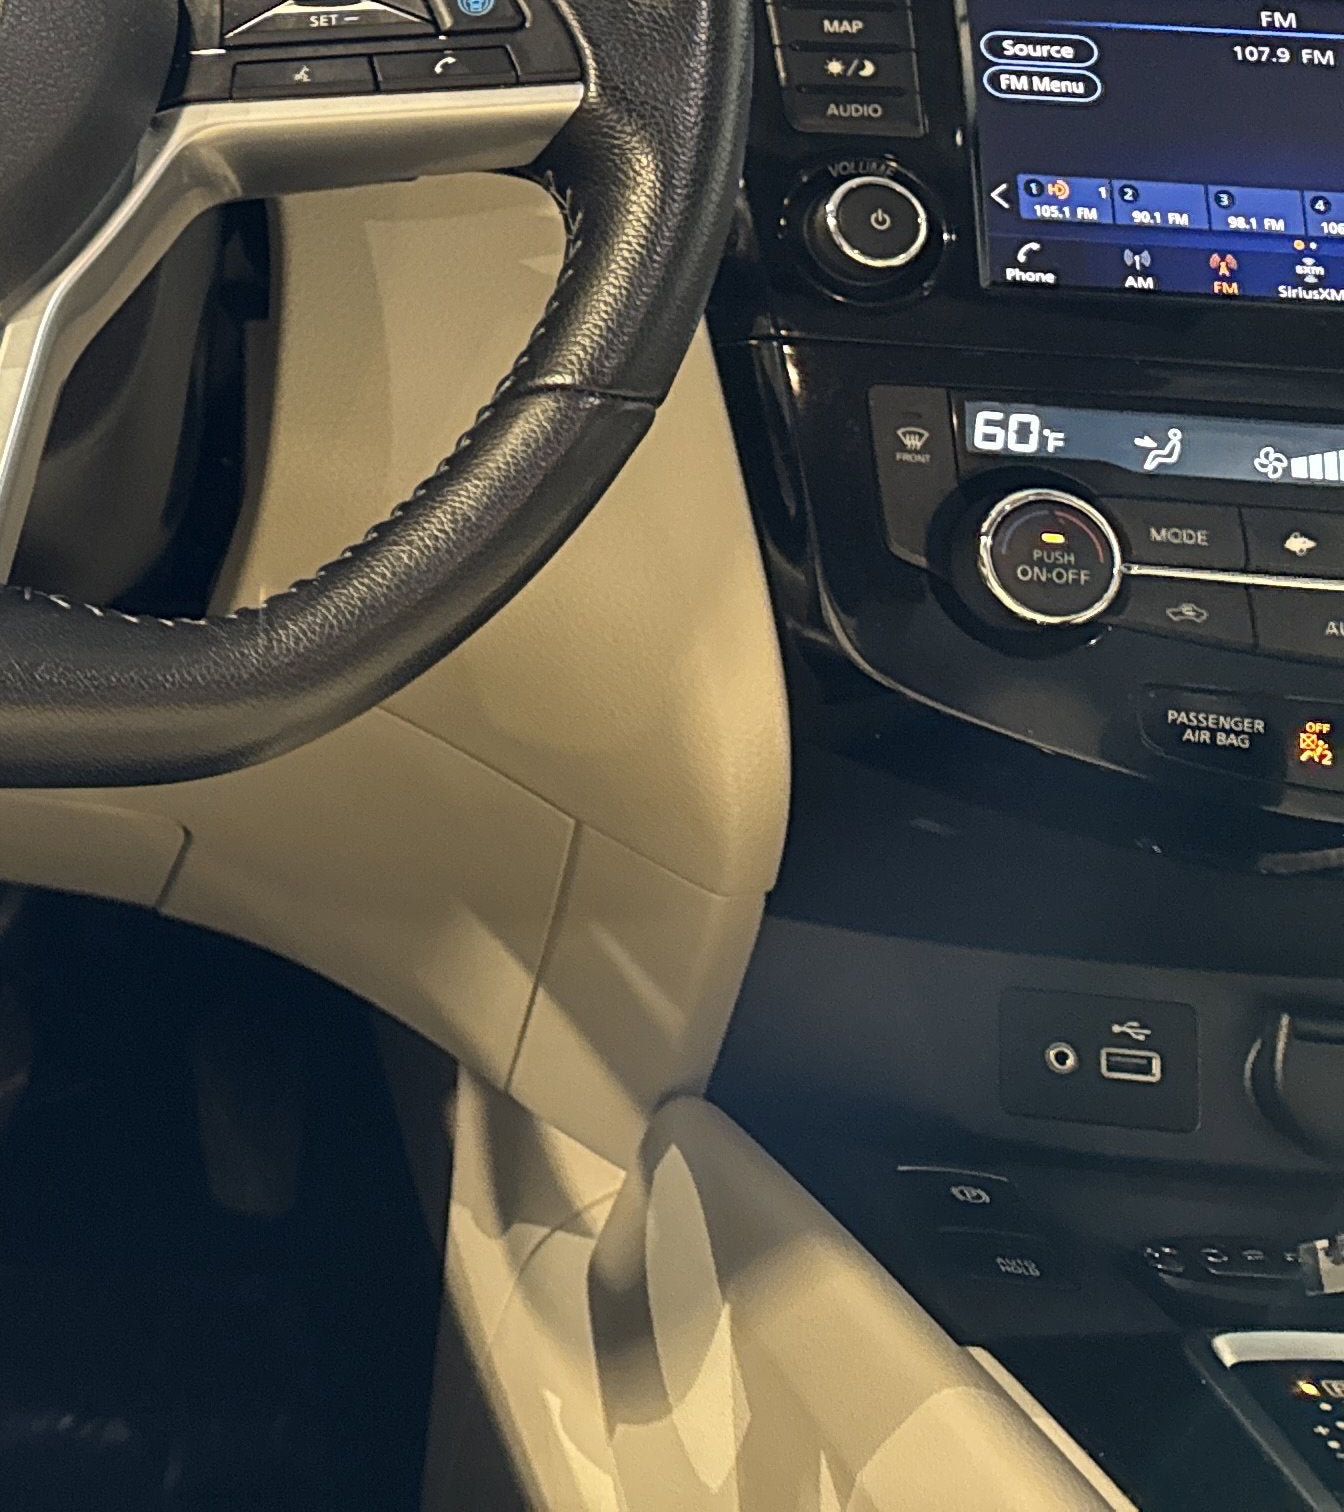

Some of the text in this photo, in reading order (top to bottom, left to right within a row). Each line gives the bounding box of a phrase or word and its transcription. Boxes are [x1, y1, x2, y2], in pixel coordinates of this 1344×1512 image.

[310, 14, 338, 27] SET
[823, 19, 864, 33] MAP
[1260, 11, 1297, 28] FM
[1002, 39, 1074, 59] Source
[1233, 45, 1335, 65] 107.9 FM
[999, 74, 1085, 94] FM Menu
[827, 103, 882, 117] AUDIO
[827, 161, 896, 178] VOLUME
[1123, 188, 1134, 200] 2
[1219, 193, 1229, 206] 3
[1034, 205, 1098, 220] 105.1 FM
[1314, 199, 1325, 211] 4
[1132, 210, 1189, 226] 90.1 FM
[1228, 216, 1285, 231] 98.1 FM
[1006, 268, 1056, 284] Phone
[1125, 276, 1154, 289] AM
[1213, 281, 1239, 295] FM
[1278, 285, 1344, 301] SiriusXM
[896, 452, 931, 463] FRONT
[1150, 527, 1209, 546] MODE
[1033, 550, 1075, 565] PUSH
[1168, 709, 1265, 733] PASSENGER
[1305, 721, 1331, 733] OFF
[1183, 729, 1250, 748] AIR BAG
